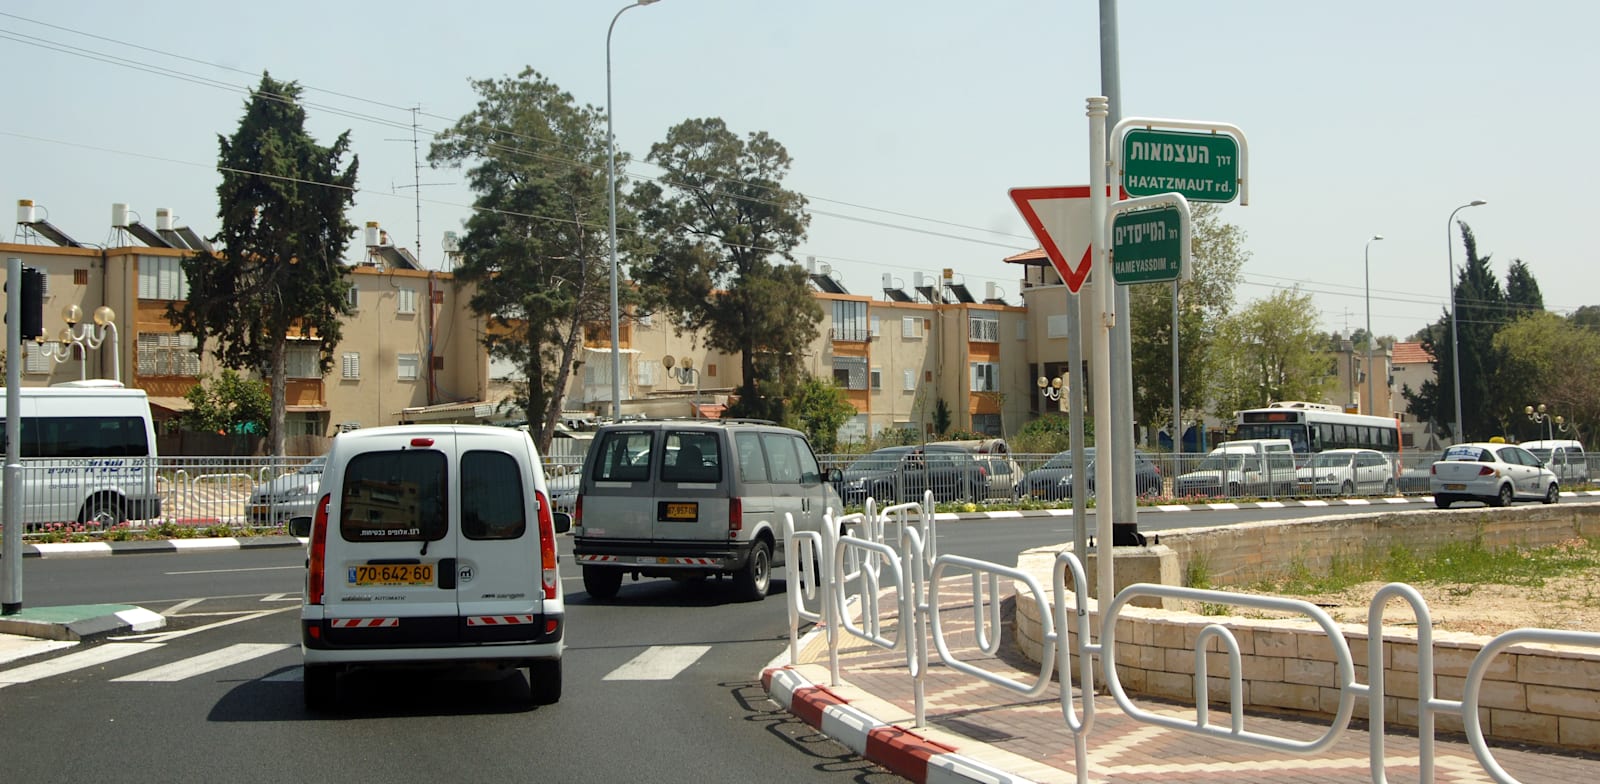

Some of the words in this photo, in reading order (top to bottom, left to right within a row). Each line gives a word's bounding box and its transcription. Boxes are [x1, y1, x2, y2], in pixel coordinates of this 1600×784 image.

[1130, 141, 1209, 164] העצמאות
[1216, 155, 1231, 168] דרך
[1128, 176, 1214, 192] HA'ATZMAUT
[1216, 181, 1232, 193] rd.
[1116, 221, 1166, 245] המייסדים
[1116, 258, 1166, 274] HAMEYASSDIM
